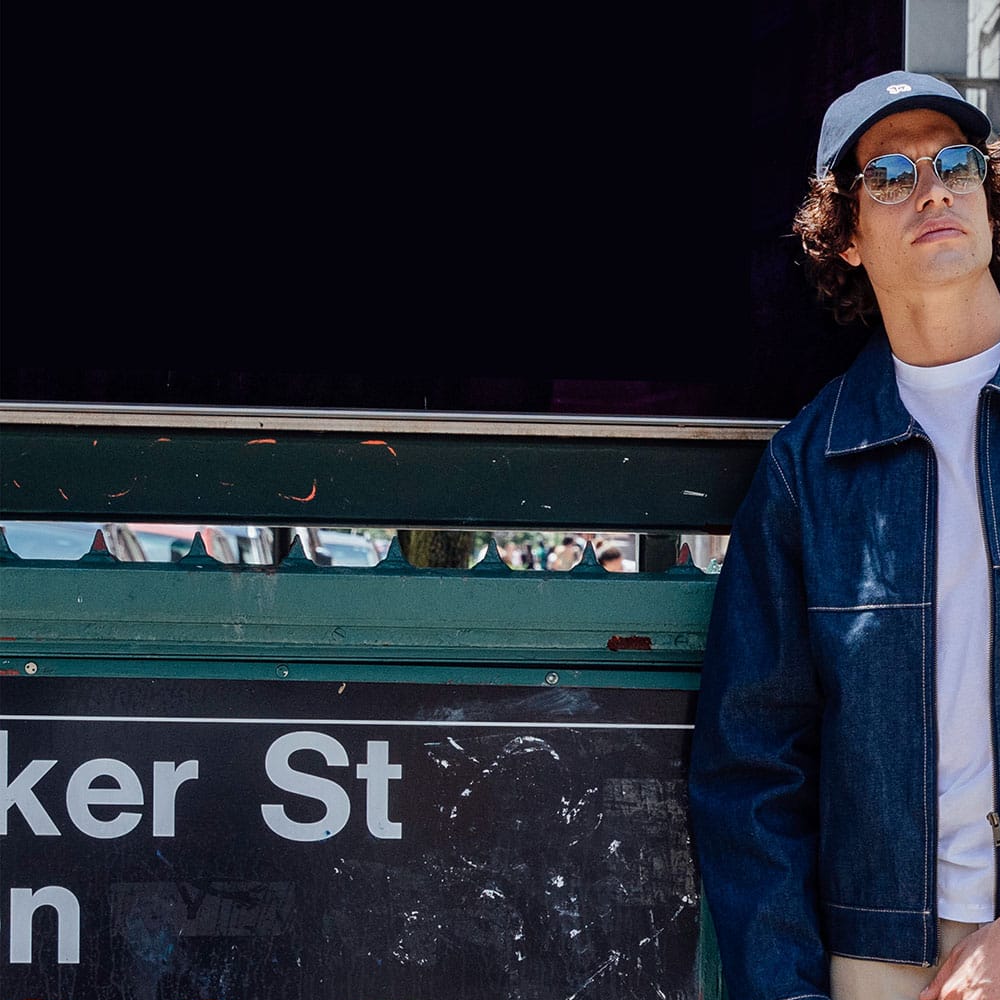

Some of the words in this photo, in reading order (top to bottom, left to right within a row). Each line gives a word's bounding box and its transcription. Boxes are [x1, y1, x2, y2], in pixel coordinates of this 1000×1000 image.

[0, 730, 199, 839] ker
[261, 730, 403, 842] St
[0, 885, 80, 964] n
